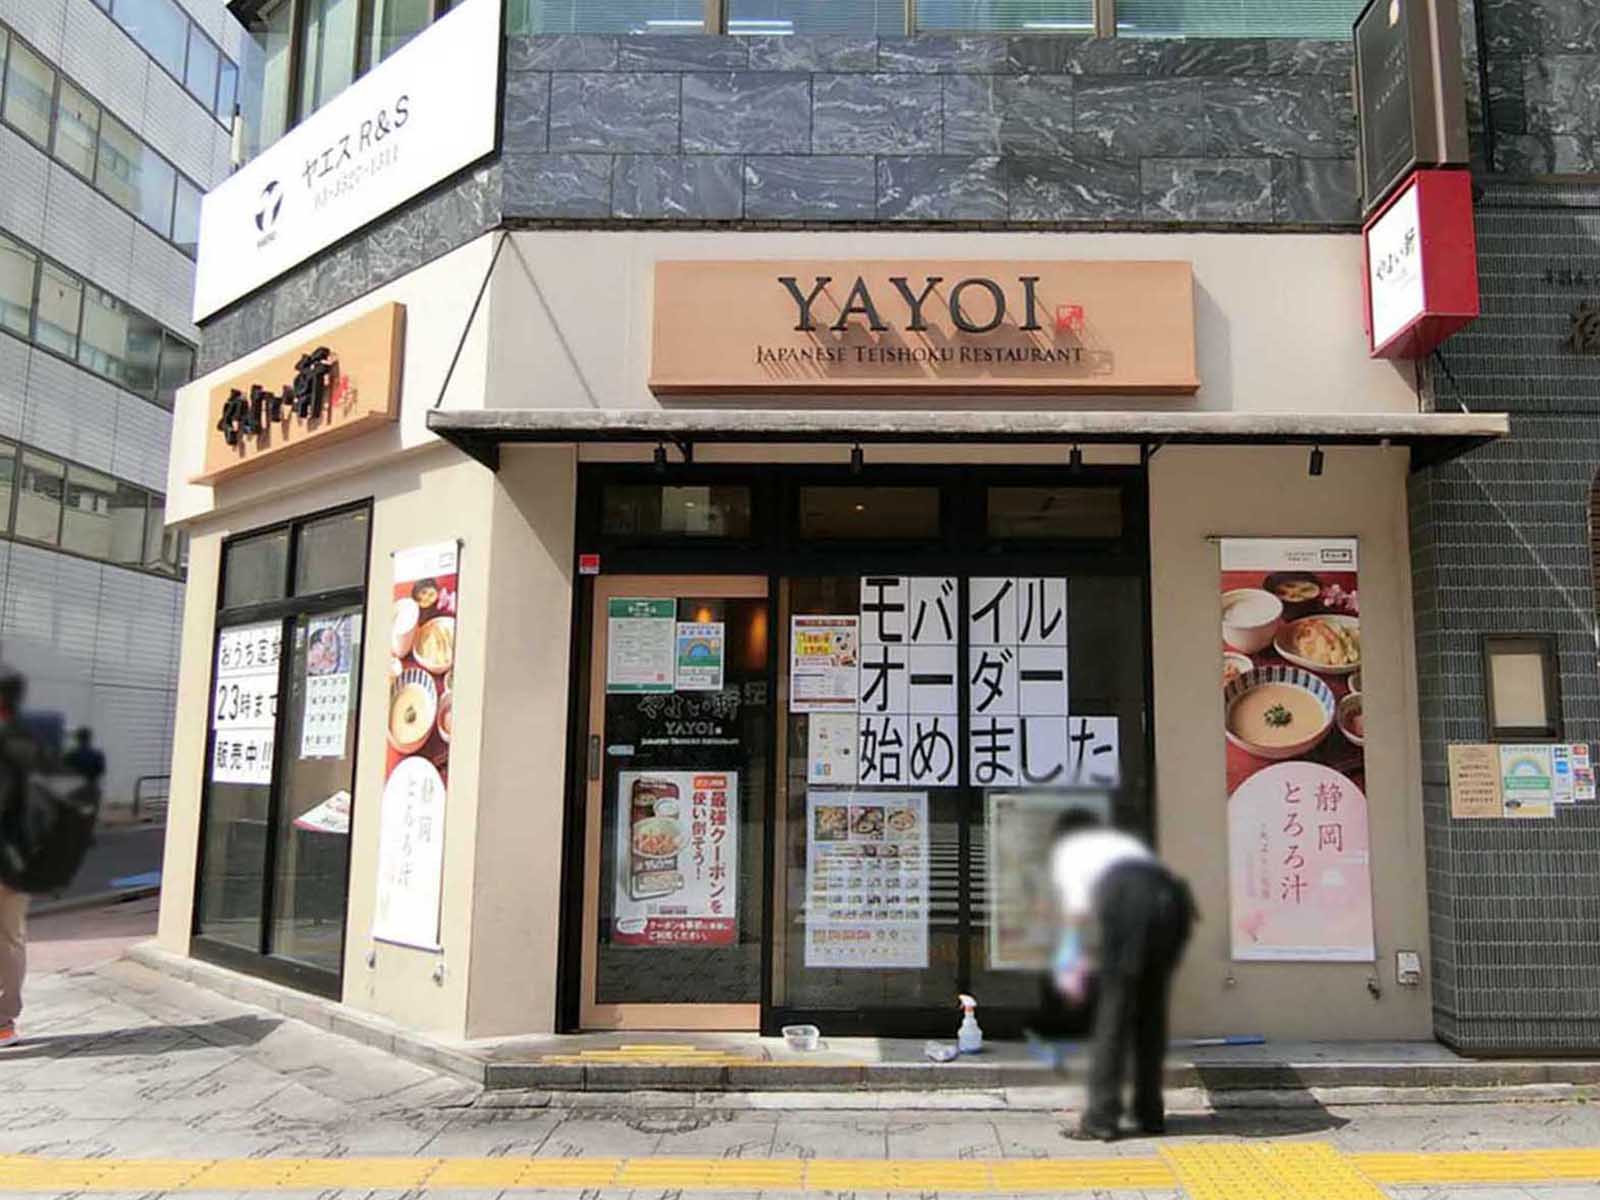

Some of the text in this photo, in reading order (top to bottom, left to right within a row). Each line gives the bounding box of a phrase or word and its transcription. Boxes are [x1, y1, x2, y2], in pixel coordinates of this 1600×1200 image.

[303, 135, 351, 188] ヤエス
[359, 94, 409, 152] R&S
[778, 276, 1041, 333] YAYOI
[756, 344, 1084, 366] JAPANESE TEISHOKU RESTAURANT
[862, 578, 1063, 643] モバイル
[861, 646, 1064, 712] オーダー
[665, 721, 714, 735] YAYOI
[860, 717, 1113, 785] 始めました
[1280, 780, 1308, 905] とろろ汁
[1314, 781, 1344, 853] 静岡
